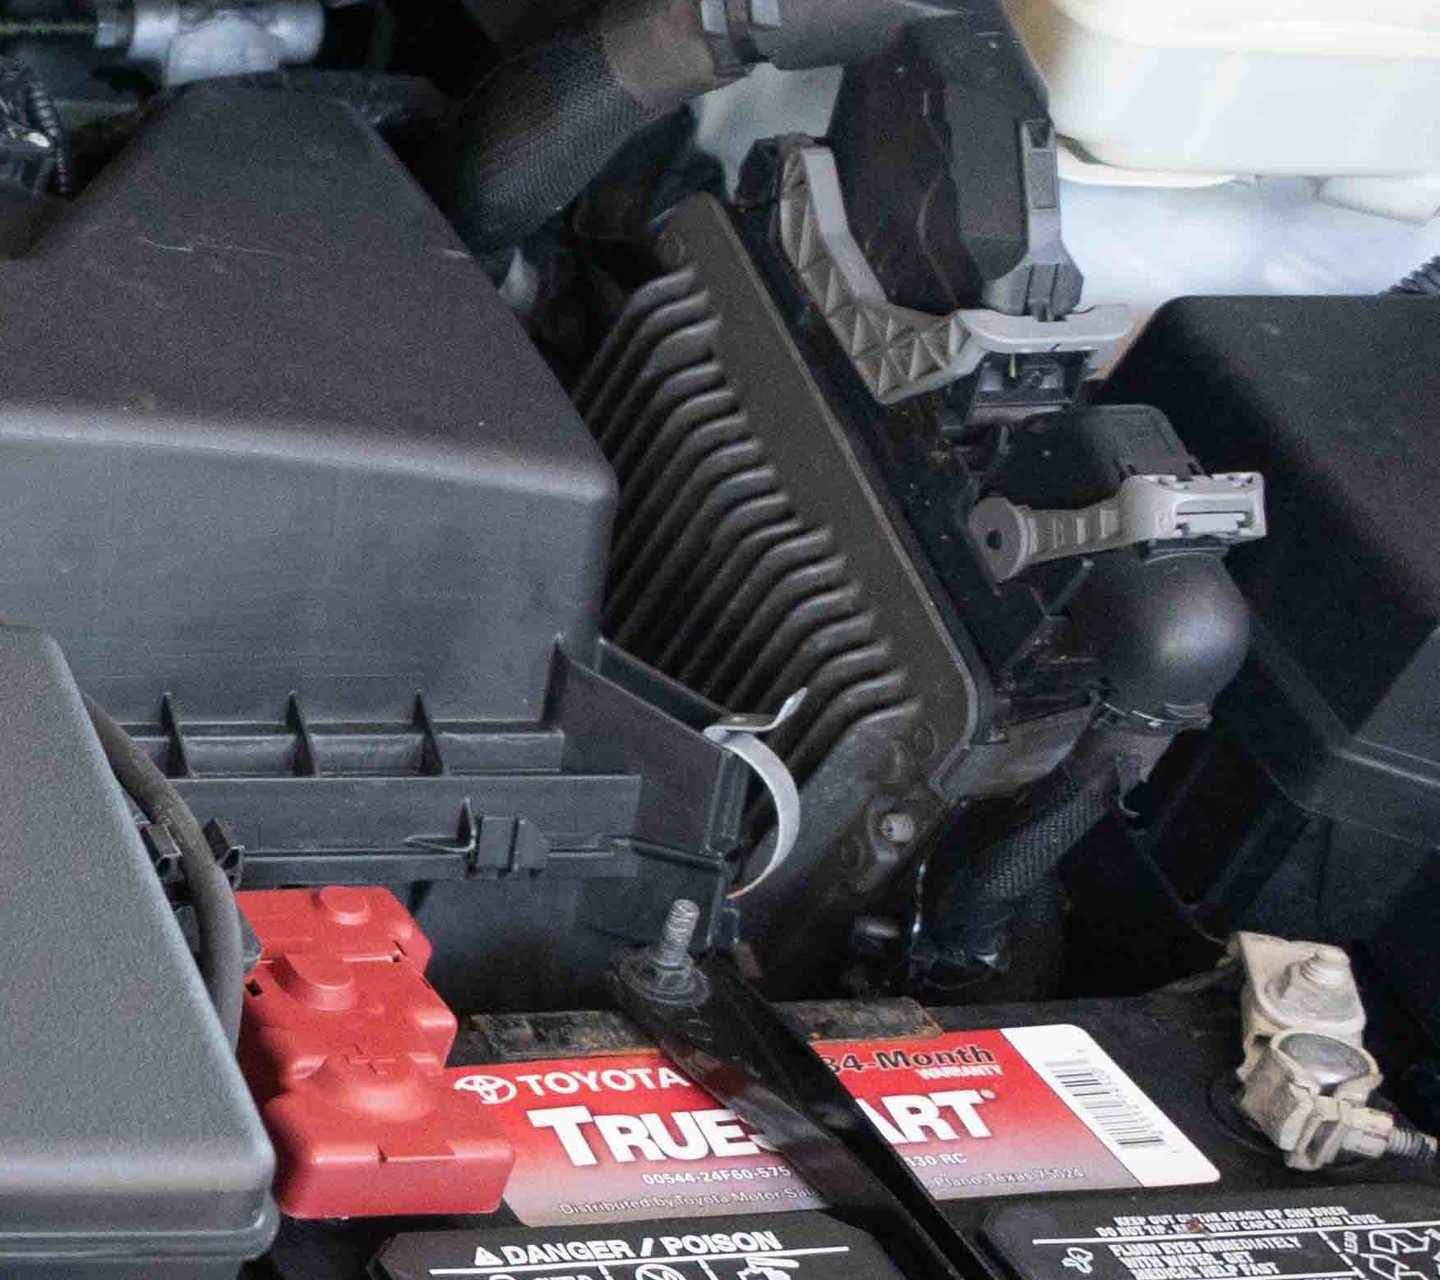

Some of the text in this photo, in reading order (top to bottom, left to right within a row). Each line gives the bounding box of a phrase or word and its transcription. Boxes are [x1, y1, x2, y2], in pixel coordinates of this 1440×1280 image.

[516, 1066, 691, 1096] TOYOTA
[731, 1190, 780, 1202] Motor
[500, 1239, 637, 1266] DANGER
[660, 1231, 783, 1256] POISON
